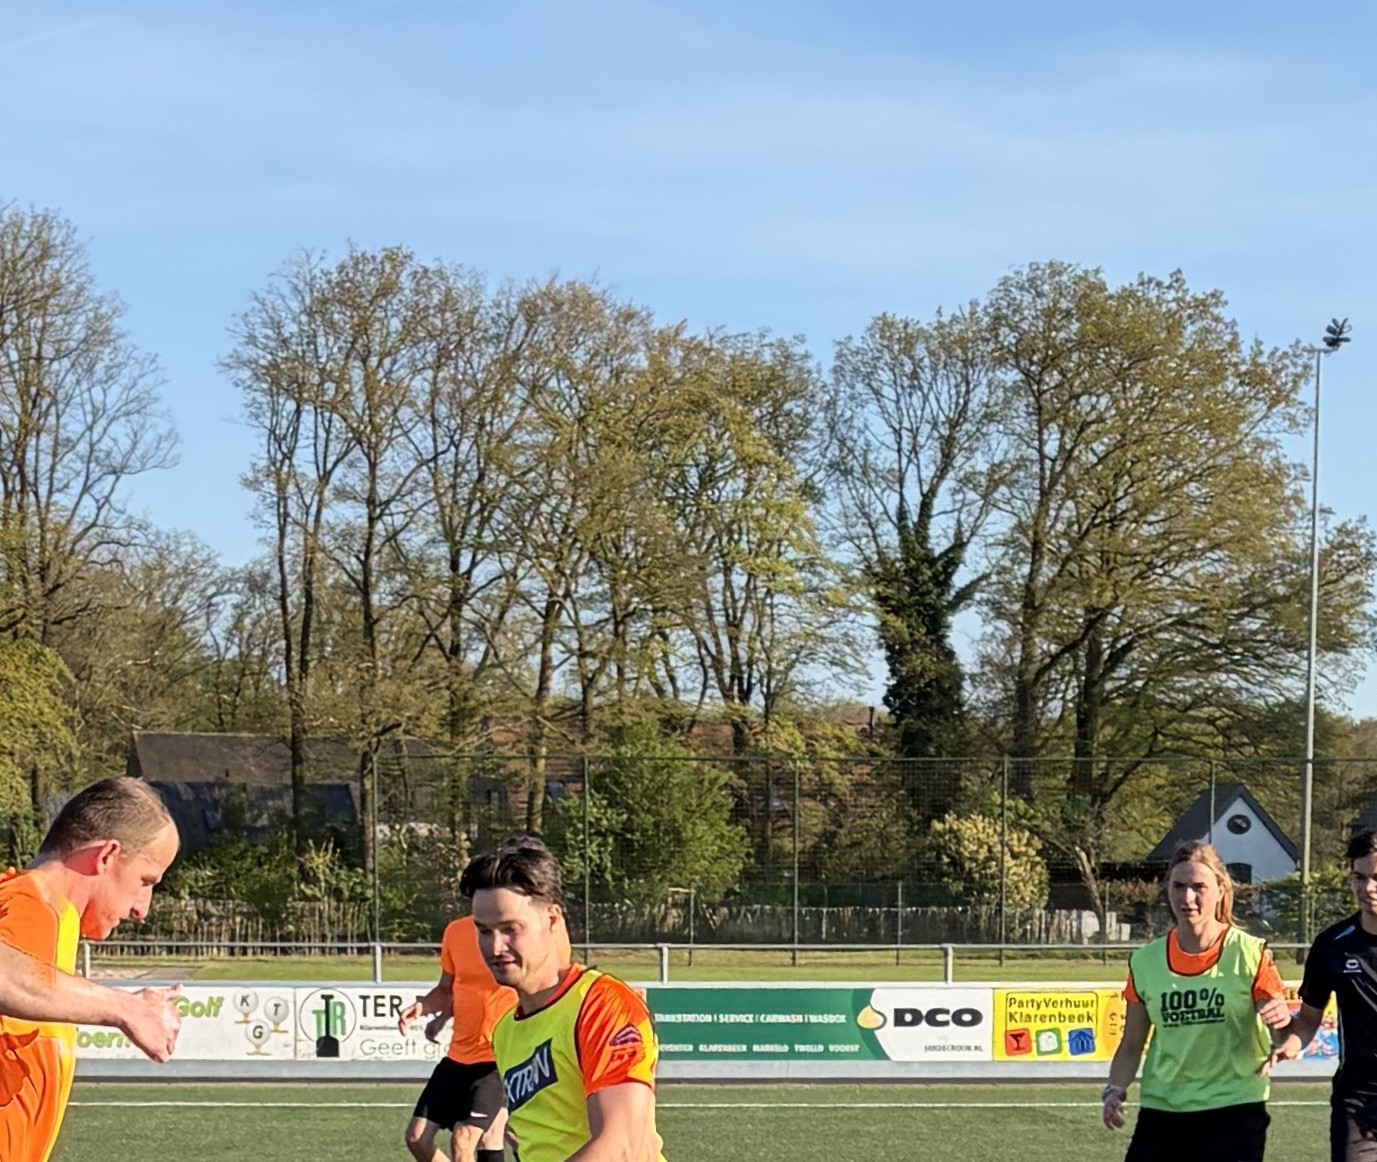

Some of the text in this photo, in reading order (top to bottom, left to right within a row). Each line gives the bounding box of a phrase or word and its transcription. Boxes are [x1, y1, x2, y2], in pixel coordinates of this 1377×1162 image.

[358, 995, 404, 1018] TER
[1160, 987, 1225, 1011] 100%
[893, 1007, 984, 1028] DCO
[1008, 1012, 1095, 1024] Klarenbeek
[360, 1038, 416, 1056] Geeft
